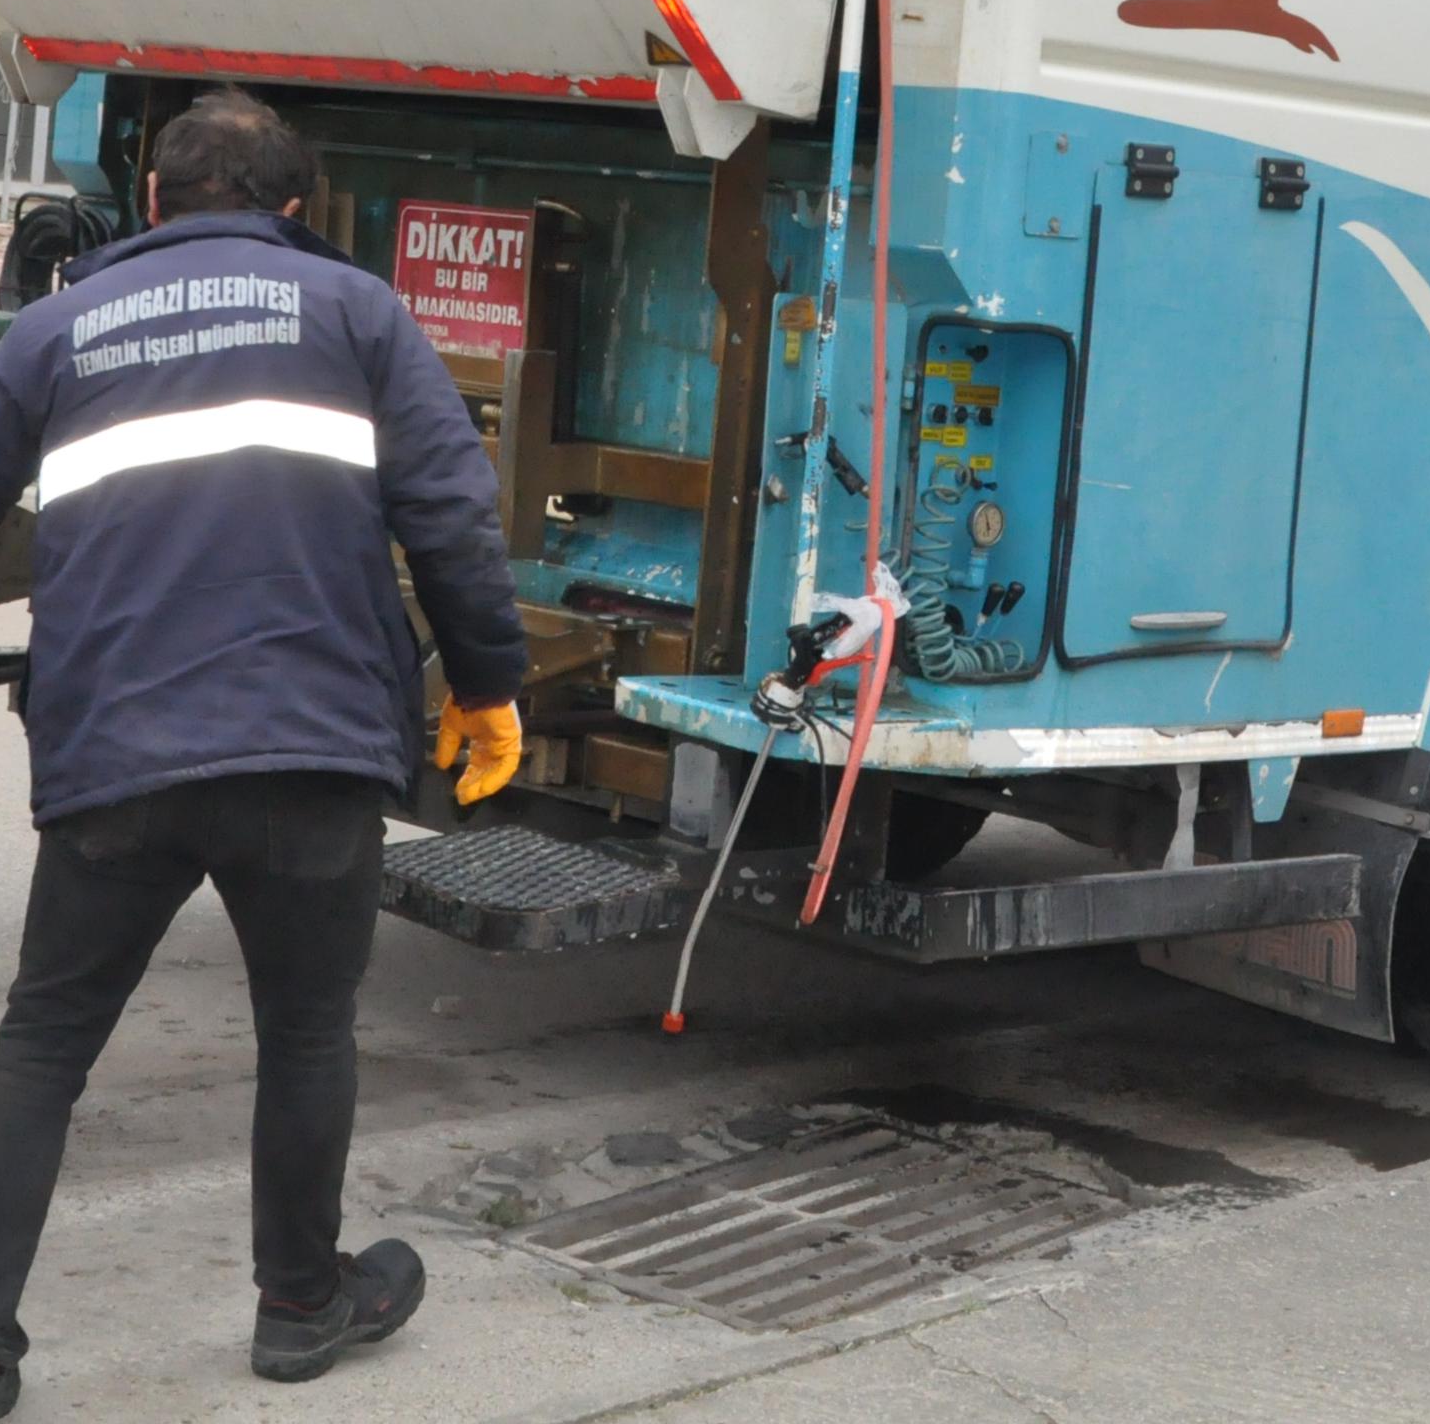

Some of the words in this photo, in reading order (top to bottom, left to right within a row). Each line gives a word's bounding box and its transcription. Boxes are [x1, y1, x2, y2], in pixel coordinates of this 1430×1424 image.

[406, 212, 524, 269] DİKKAT!
[435, 268, 457, 289] BU
[461, 266, 488, 292] BİR
[73, 278, 185, 350] ORHANGAZİ
[188, 273, 301, 317] BELEDİYESİ
[415, 294, 522, 326] MAKİNASIDIR.
[73, 339, 142, 378] TEMİZLİK
[144, 330, 195, 366] İŞLERİ
[197, 318, 301, 354] MÜDÜRLÜĞÜ
